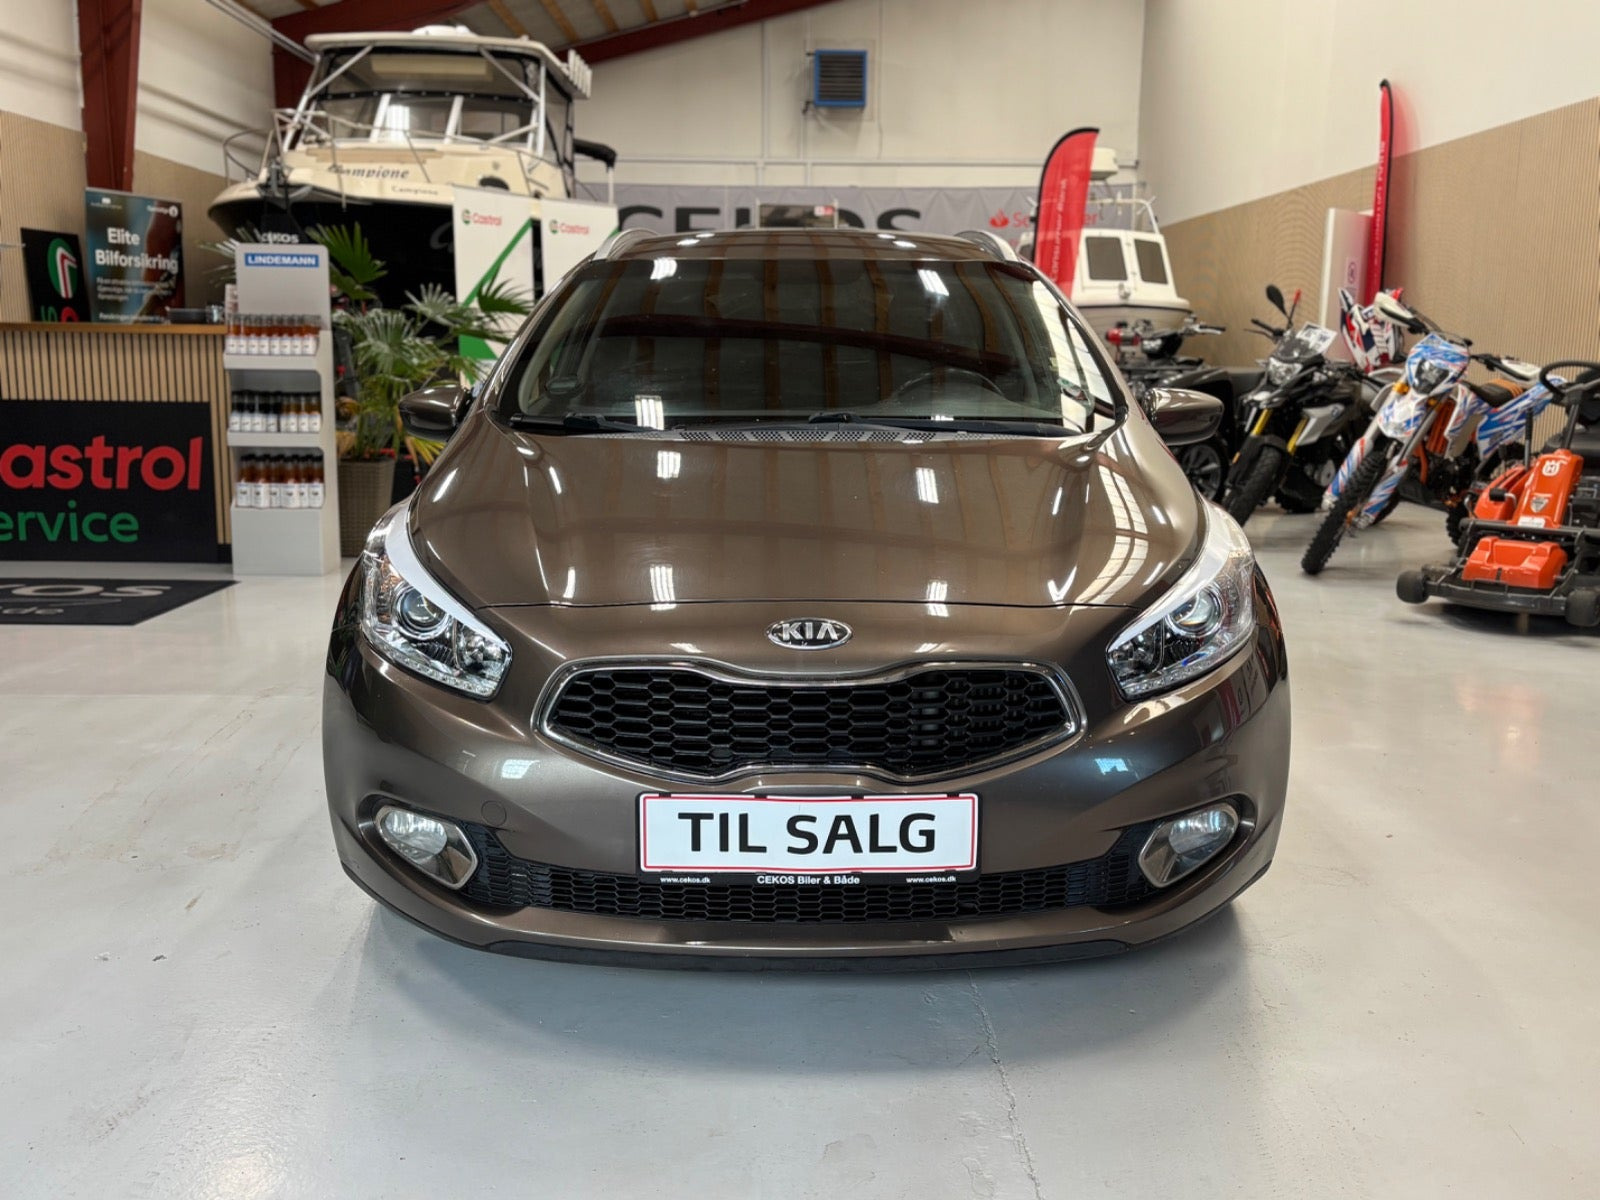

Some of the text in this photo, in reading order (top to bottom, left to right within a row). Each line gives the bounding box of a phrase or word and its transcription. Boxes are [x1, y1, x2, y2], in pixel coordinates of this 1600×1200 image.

[473, 213, 502, 226] Castrol
[559, 223, 589, 235] Castrol
[107, 227, 140, 245] Elite
[95, 249, 178, 274] Bilforsikring
[247, 254, 317, 266] LINDEMANN
[0, 435, 203, 491] astrol
[782, 622, 839, 641] KIA
[678, 812, 936, 855] TIL SALG
[660, 876, 710, 884] www.cekos.dk
[757, 874, 860, 884] CEKOS Biler & Både
[906, 876, 956, 884] www.cekos.dk
